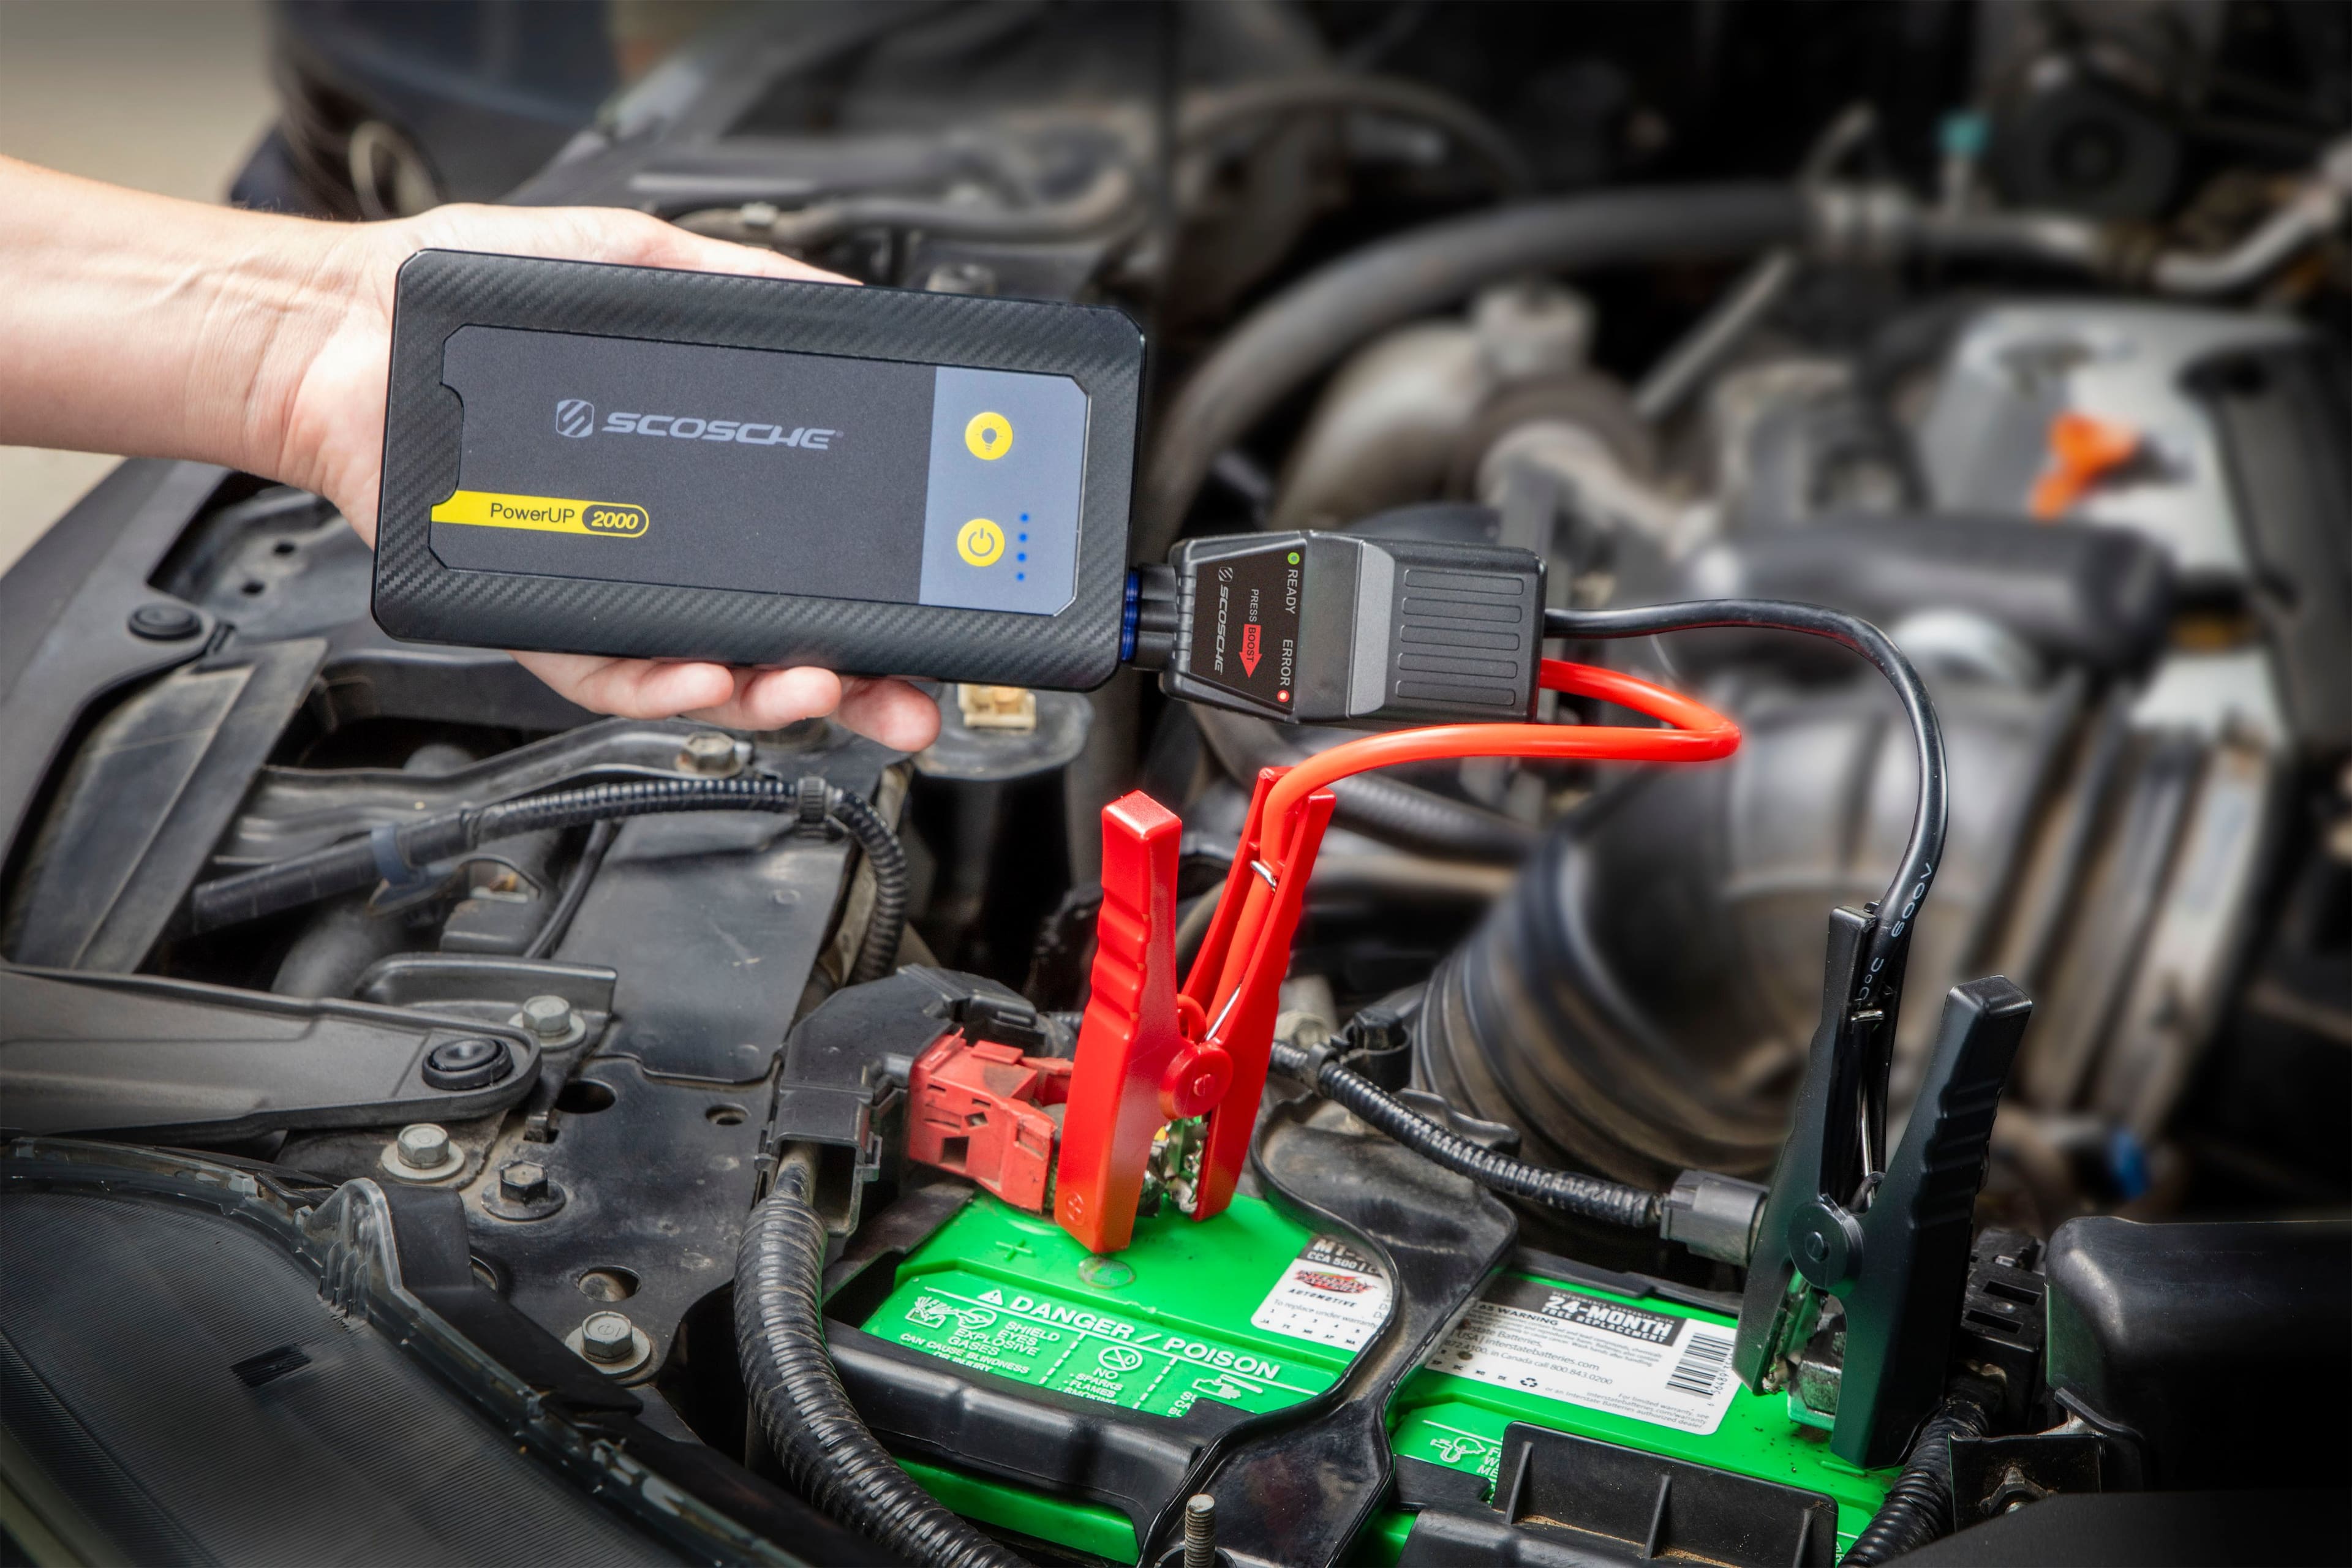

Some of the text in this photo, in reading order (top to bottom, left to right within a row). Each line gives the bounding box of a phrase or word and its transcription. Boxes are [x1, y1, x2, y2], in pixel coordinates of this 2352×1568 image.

[602, 412, 836, 450] SCOSCHE
[490, 502, 639, 530] PowerUP 2000
[1248, 588, 1260, 623] PRESS
[1284, 568, 1298, 615] READY
[1215, 584, 1229, 675] SCOSCHE
[1246, 626, 1256, 663] BOOST
[1279, 639, 1294, 687] ERROR
[1891, 862, 1932, 937] 600V
[1306, 1251, 1330, 1263] CCA
[1333, 1257, 1357, 1269] 500
[1284, 1302, 1314, 1313] replace
[1315, 1308, 1342, 1319] under
[1288, 1289, 1357, 1307] AUTOMOTIVE
[1003, 1319, 1061, 1343] SHIELD
[1497, 1306, 1559, 1326] WARNING
[1540, 1306, 1667, 1343] FREE REPLACEMENT
[1544, 1295, 1673, 1337] 24-MONTH
[899, 1332, 1030, 1374] CAN CAUSE BLINDNESS
[946, 1335, 1001, 1357] GASES
[953, 1326, 1039, 1357] EXPLOSIVE
[997, 1328, 1039, 1347] EYES
[1009, 1294, 1136, 1341] DANGER
[1162, 1335, 1281, 1381] POISON
[1457, 1330, 1480, 1342] USA
[1484, 1336, 1601, 1371] interstatebatteries.com
[1497, 1330, 1545, 1348] Batteries,
[1075, 1372, 1123, 1391] SPARKS
[1092, 1366, 1119, 1381] NO
[1499, 1352, 1533, 1365] Canada
[1548, 1364, 1614, 1385] 800.843.0200
[1069, 1379, 1116, 1398] FLAMES
[1631, 1396, 1659, 1407] limited
[1565, 1391, 1601, 1404] Interstate
[1602, 1400, 1635, 1412] Batteries
[1635, 1409, 1677, 1422] authorized
[1586, 1391, 1707, 1424] interstatebatteries.com/warranty
